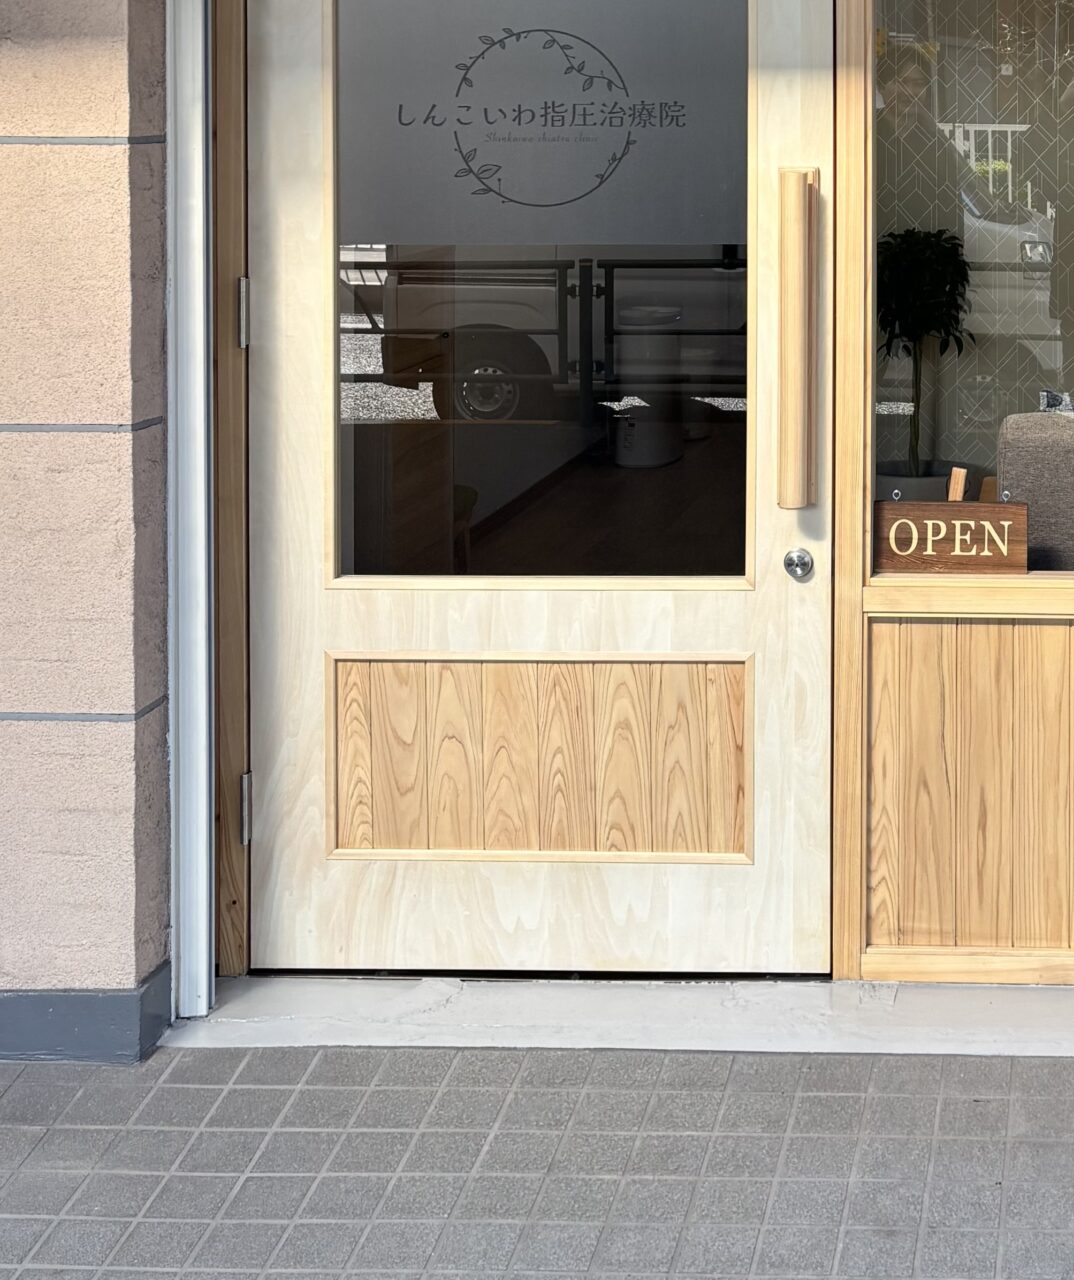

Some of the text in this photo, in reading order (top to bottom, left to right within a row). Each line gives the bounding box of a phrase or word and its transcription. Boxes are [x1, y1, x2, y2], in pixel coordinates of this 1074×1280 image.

[397, 100, 688, 129] しんこいわ指圧治療院
[887, 518, 1013, 558] OPEN
